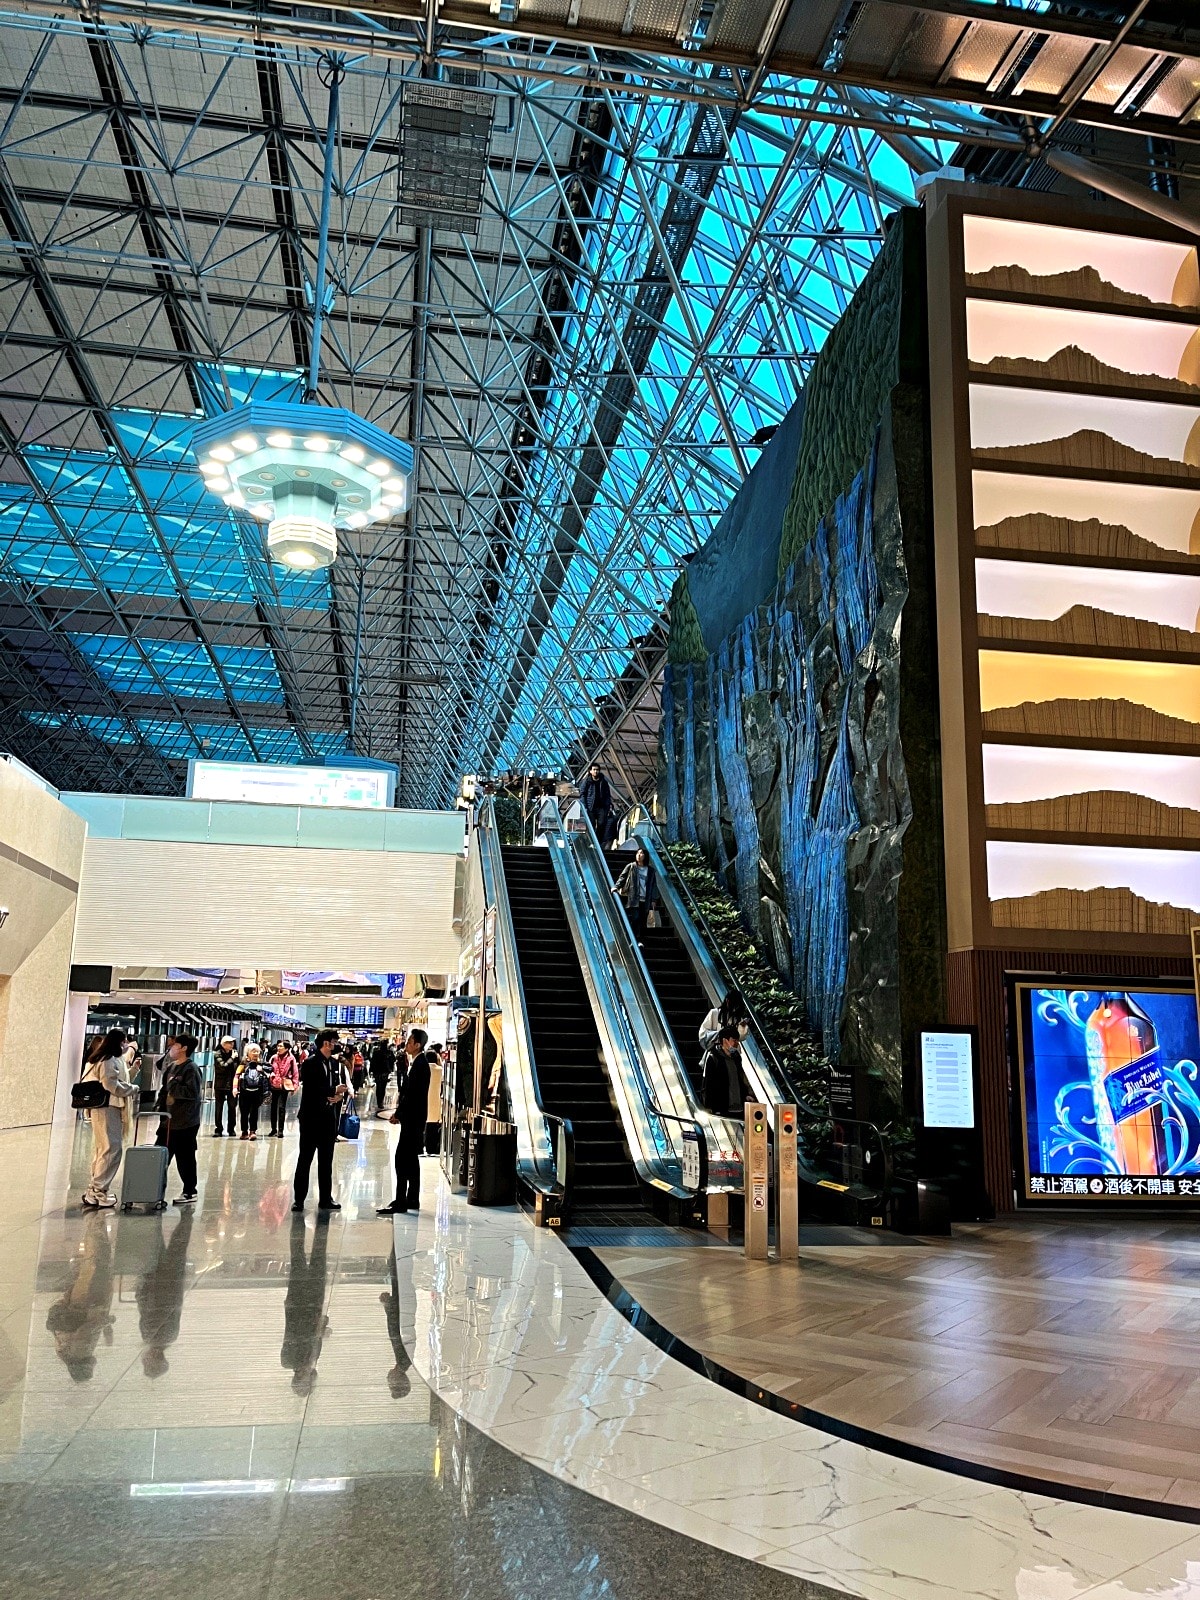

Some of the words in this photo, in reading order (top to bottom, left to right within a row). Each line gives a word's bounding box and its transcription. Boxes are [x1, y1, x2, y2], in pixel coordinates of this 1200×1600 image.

[1140, 1067, 1162, 1087] Label
[1030, 1177, 1089, 1195] 禁止酒駕
[1104, 1178, 1176, 1195] 酒後不開車
